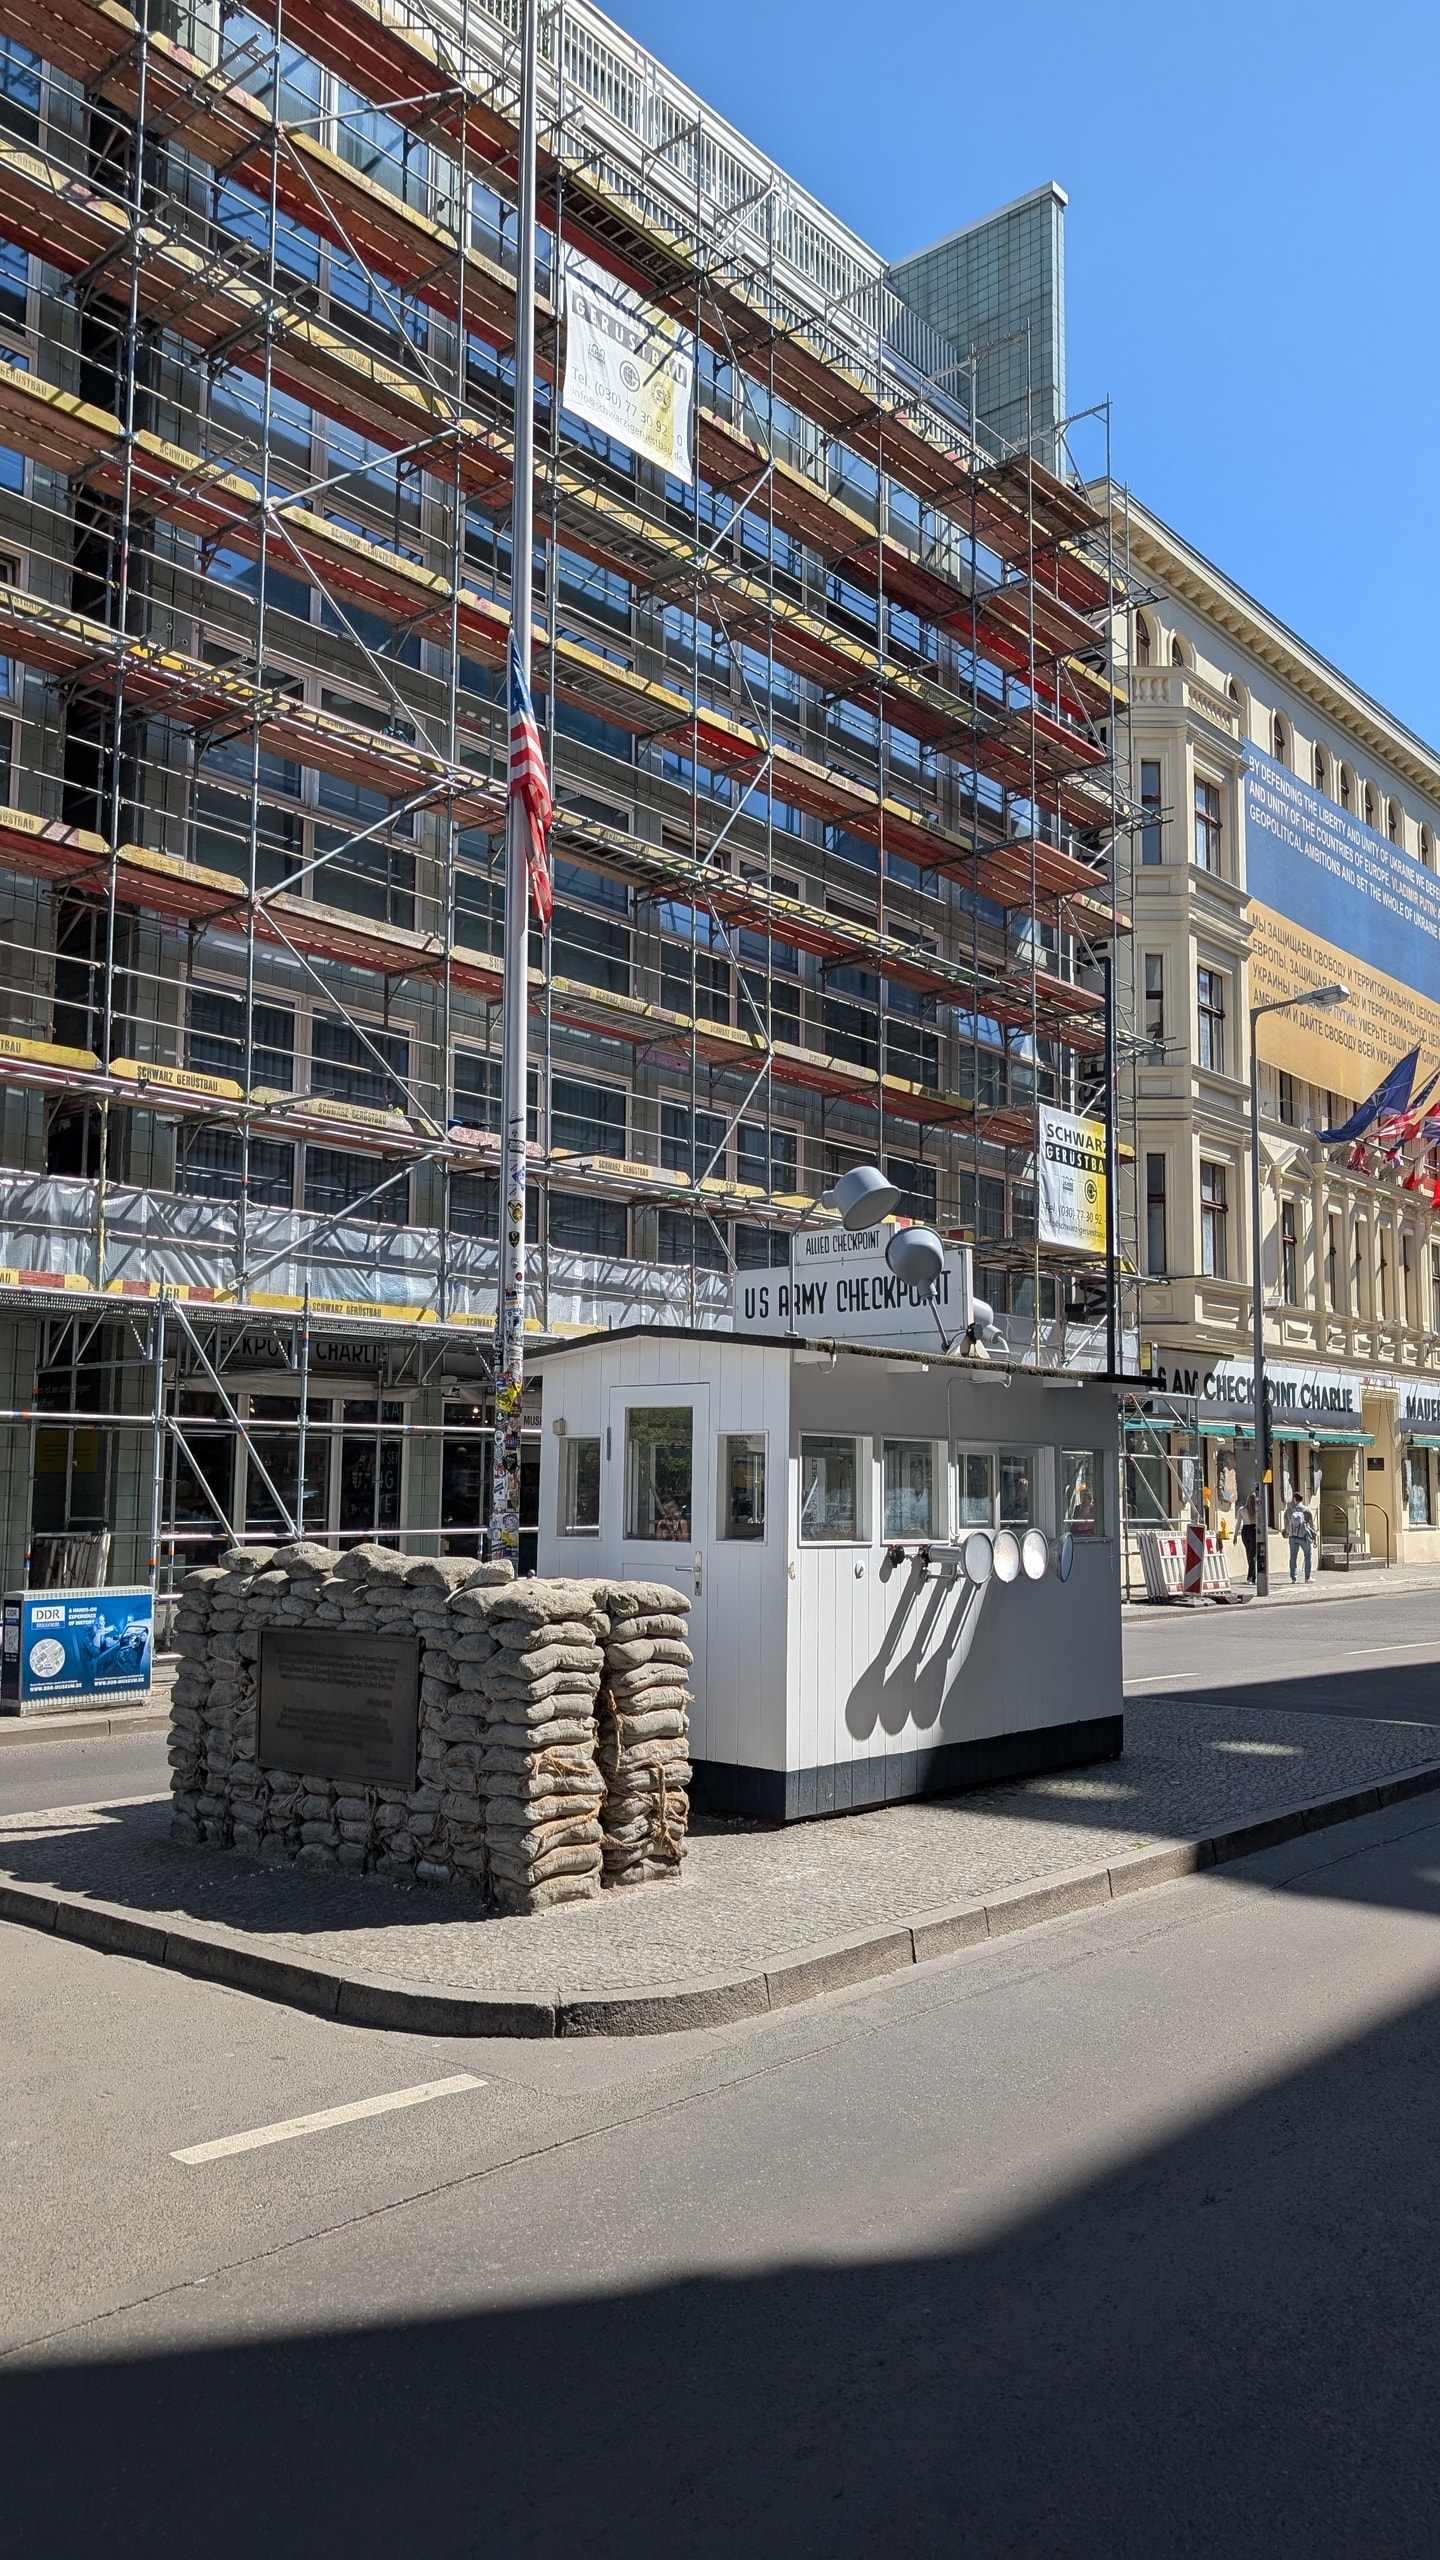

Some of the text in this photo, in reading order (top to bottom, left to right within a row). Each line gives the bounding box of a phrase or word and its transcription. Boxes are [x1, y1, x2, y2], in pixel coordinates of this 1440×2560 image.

[571, 366, 591, 389] Tel.
[594, 380, 621, 409] (030)
[625, 400, 637, 417] 77
[640, 410, 653, 427] 30
[656, 420, 668, 437] 92
[677, 434, 683, 446] 0
[159, 444, 194, 468] SCHWARZ
[1249, 755, 1260, 775] BY
[1261, 762, 1303, 806] DEFENDING
[1303, 795, 1318, 817] THE
[1318, 805, 1347, 836] LIBERTY
[1346, 825, 1361, 846] AND
[1361, 836, 1380, 859] UNITY
[1380, 848, 1390, 863] OF
[1390, 854, 1415, 884] UKRAINE
[1415, 872, 1425, 890] WE
[1249, 780, 1265, 803] AND
[1267, 789, 1290, 820] UNITY
[1290, 807, 1300, 827] OF
[1301, 815, 1316, 837] THE
[1316, 826, 1354, 863] COUNTRIES
[1354, 852, 1364, 869] OF
[1391, 876, 1419, 906] VLADIMIR
[1249, 804, 1438, 939] GEOPOLITICAL AMBITIONS AND SET THE WHOLE OF UKRAINE
[1252, 912, 1266, 934] МЫ
[1268, 922, 1313, 961] ЗАЩИЩАЕМ
[1313, 949, 1346, 979] СВОБОДУ
[1347, 967, 1352, 982] И
[1353, 970, 1415, 1015] ТЕРРИТОРИАЛЬНУЮ
[1300, 1010, 1323, 1036] ДАЙТЕ
[1324, 1023, 1357, 1051] СВОБОДУ
[1357, 1038, 1375, 1060] ВСЕЙ
[137, 1065, 218, 1092] SCHWARZ GERÜSTBAU
[1046, 1144, 1105, 1173] GERÜSTBA
[1059, 1204, 1075, 1220] (030)
[1077, 1209, 1084, 1220] 77
[1085, 1211, 1093, 1222] 30
[1094, 1213, 1102, 1225] 92
[805, 1230, 881, 1256] ALLIED CHECKPOINT
[312, 1302, 382, 1318] SCHWARZ GERÜSTBAU
[466, 1317, 493, 1328] SCHWARZ
[1172, 1368, 1199, 1397] AM
[1300, 1383, 1353, 1413] CHARLIE
[36, 1609, 60, 1620] DDR
